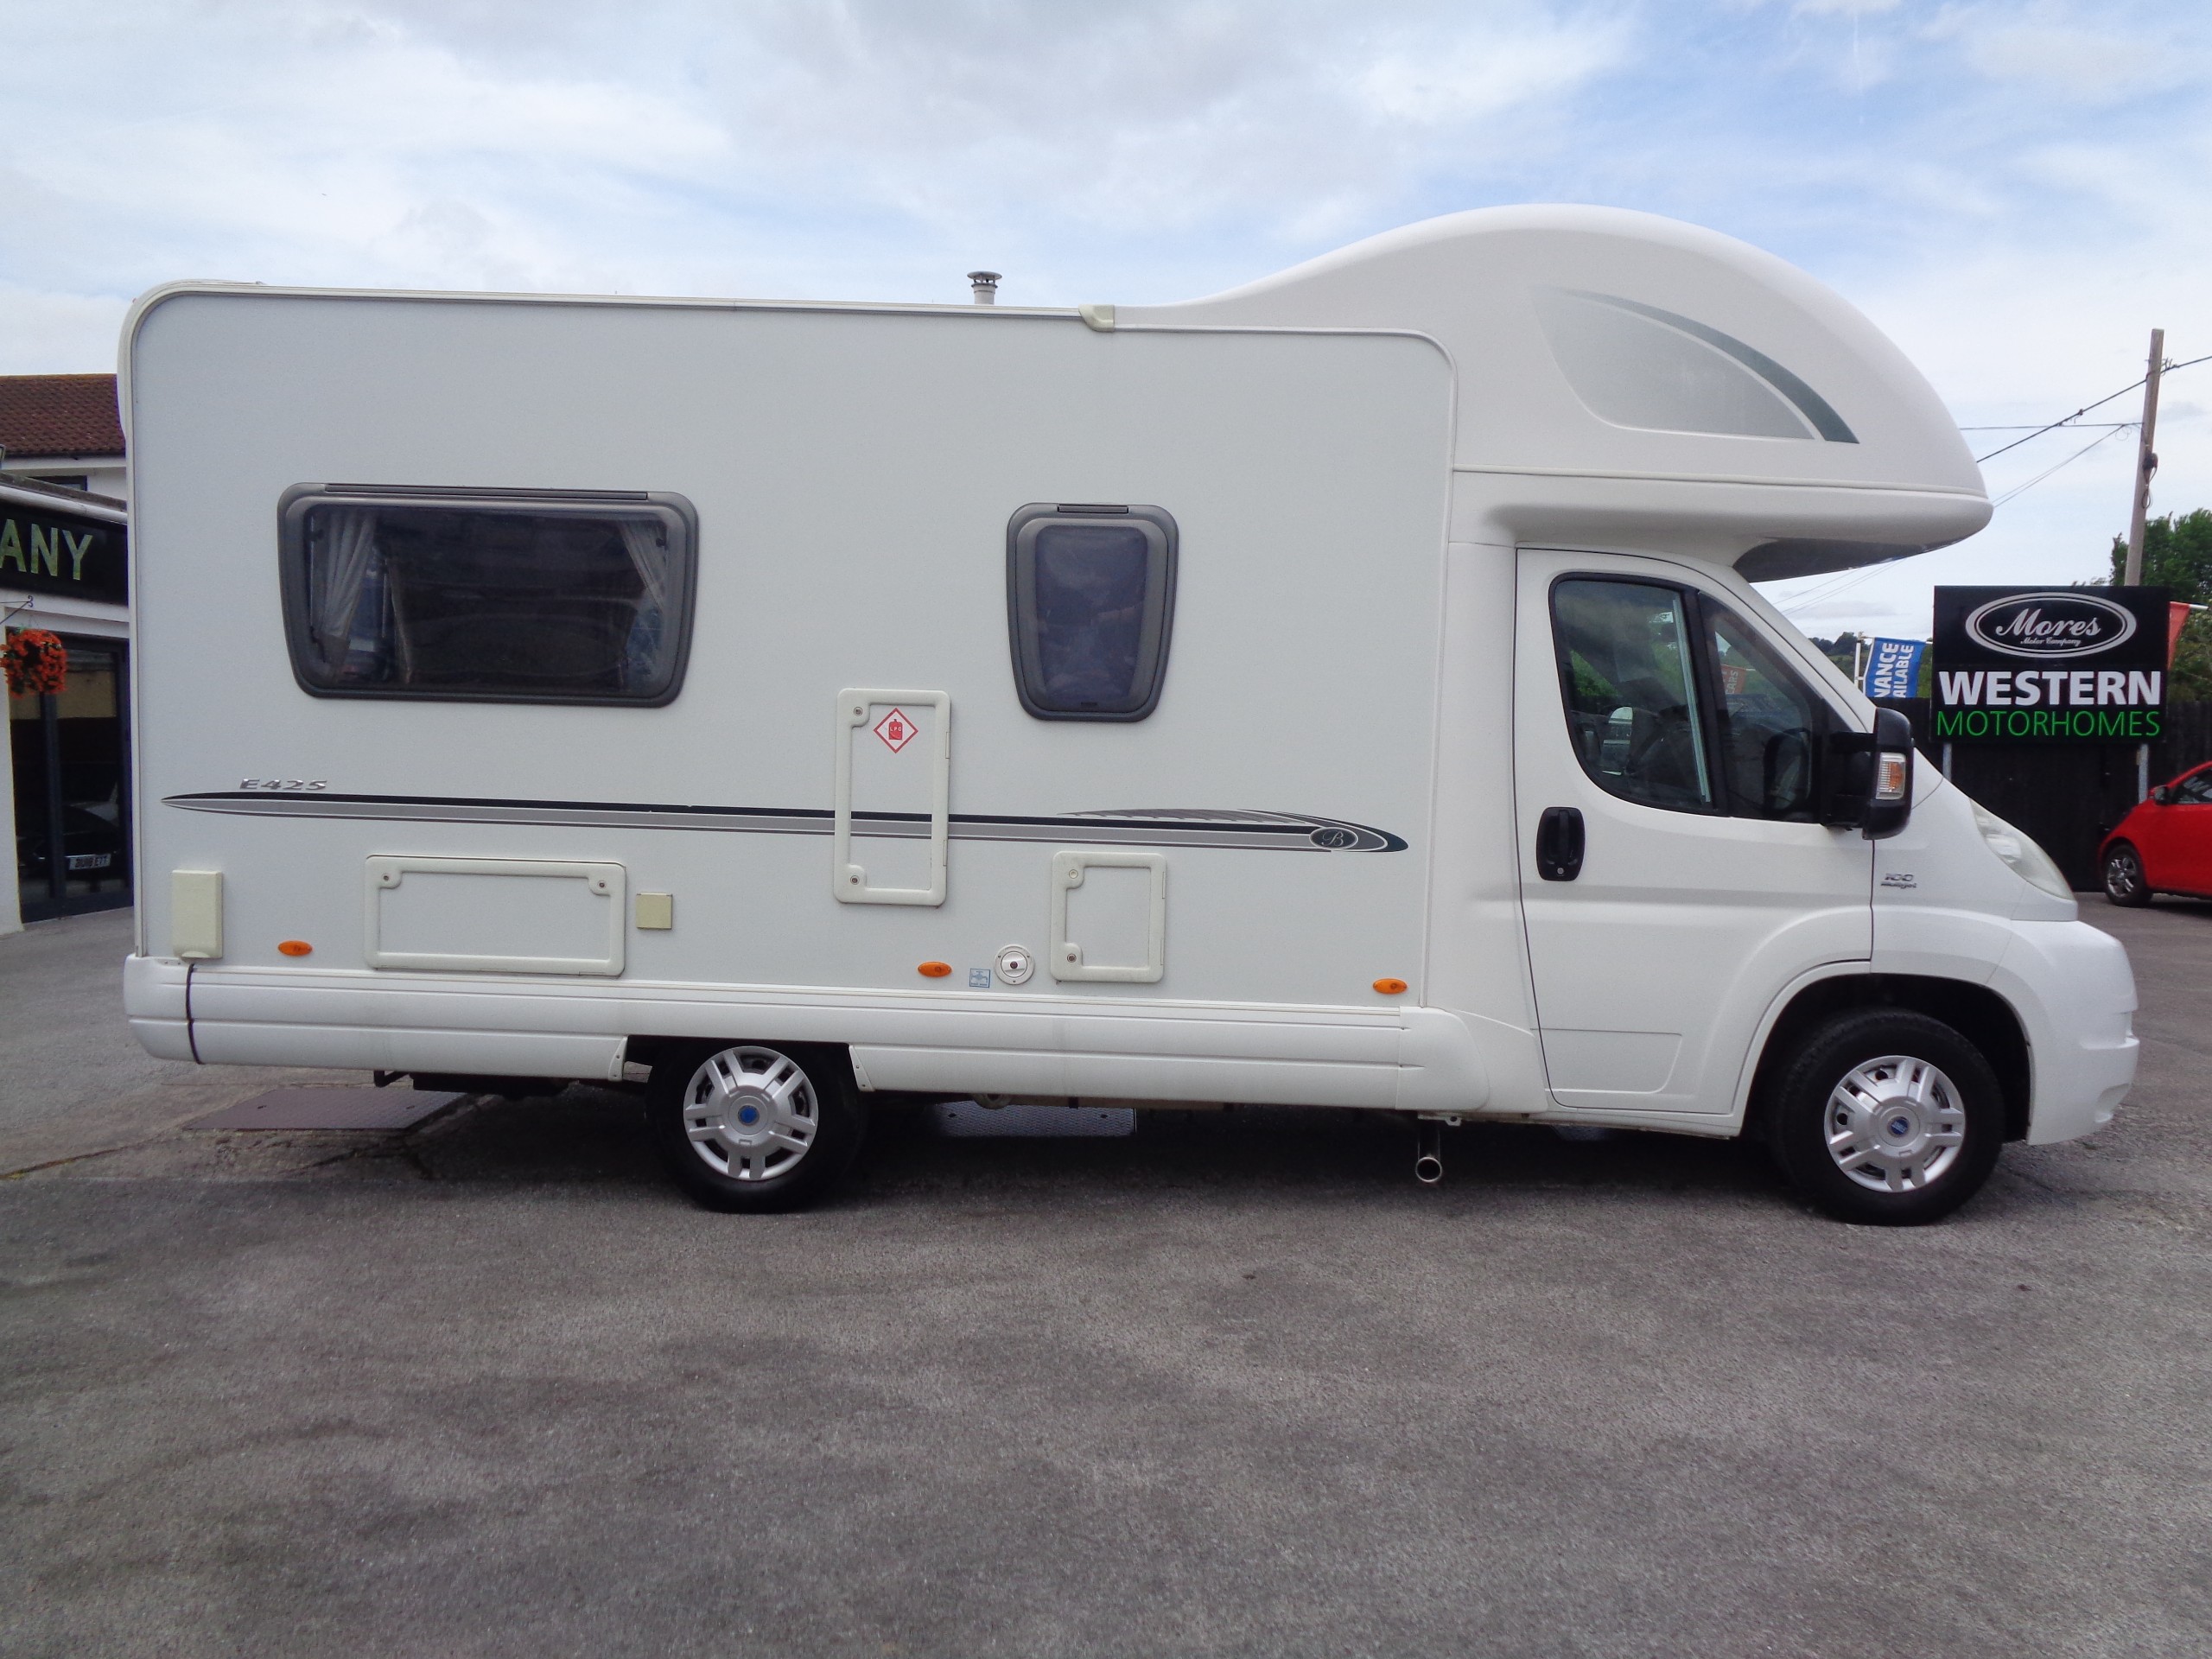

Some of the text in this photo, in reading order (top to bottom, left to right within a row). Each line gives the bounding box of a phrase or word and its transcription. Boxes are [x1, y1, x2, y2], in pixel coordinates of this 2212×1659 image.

[0, 518, 93, 581] ANY
[1995, 607, 2101, 636] Mores
[2020, 637, 2082, 647] Motor Company
[1938, 671, 2161, 706] WESTERN
[1936, 710, 2161, 736] MOTORHOMES
[239, 779, 327, 791] E425
